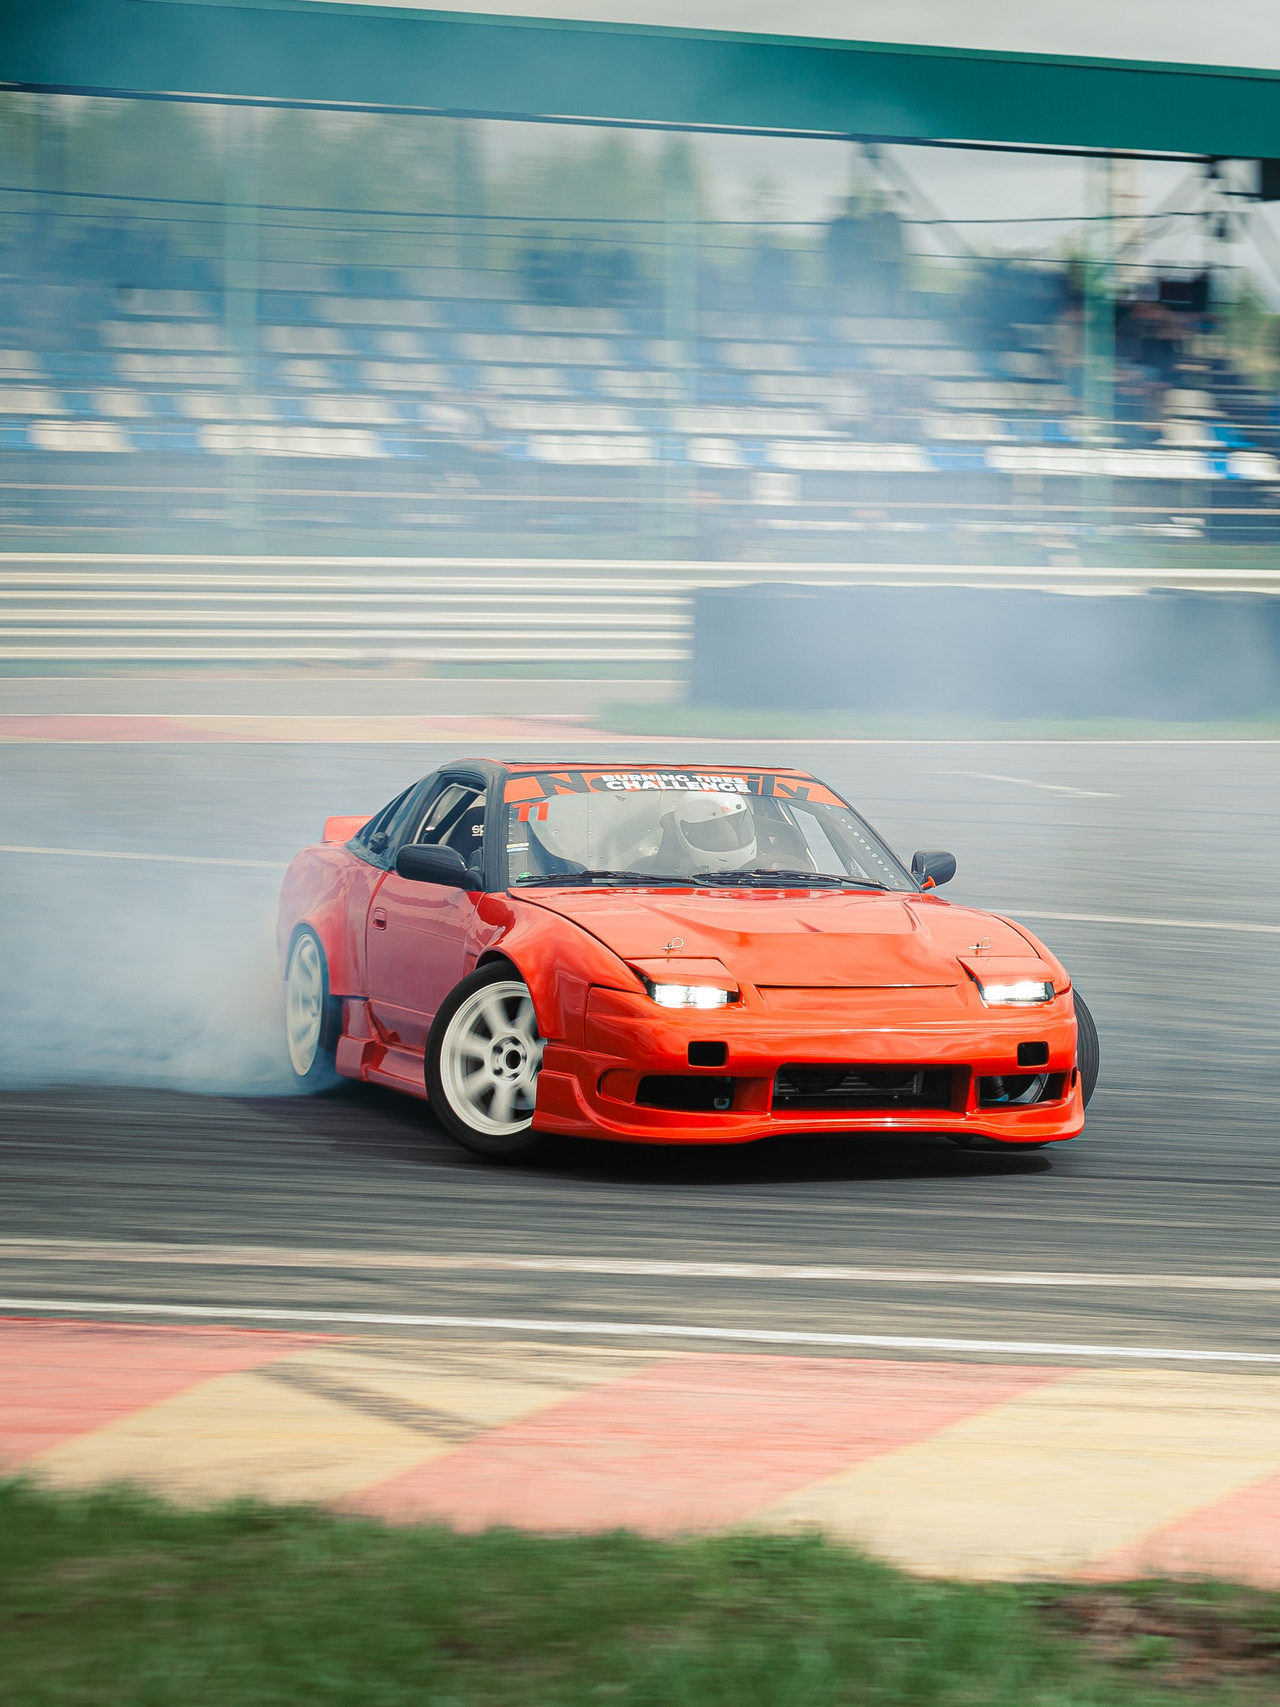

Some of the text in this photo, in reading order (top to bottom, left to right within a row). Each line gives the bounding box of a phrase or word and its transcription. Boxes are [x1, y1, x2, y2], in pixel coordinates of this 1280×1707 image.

[601, 774, 746, 784] BURNING TIRES
[605, 780, 752, 793] CHALLENGE
[511, 802, 549, 822] 11
